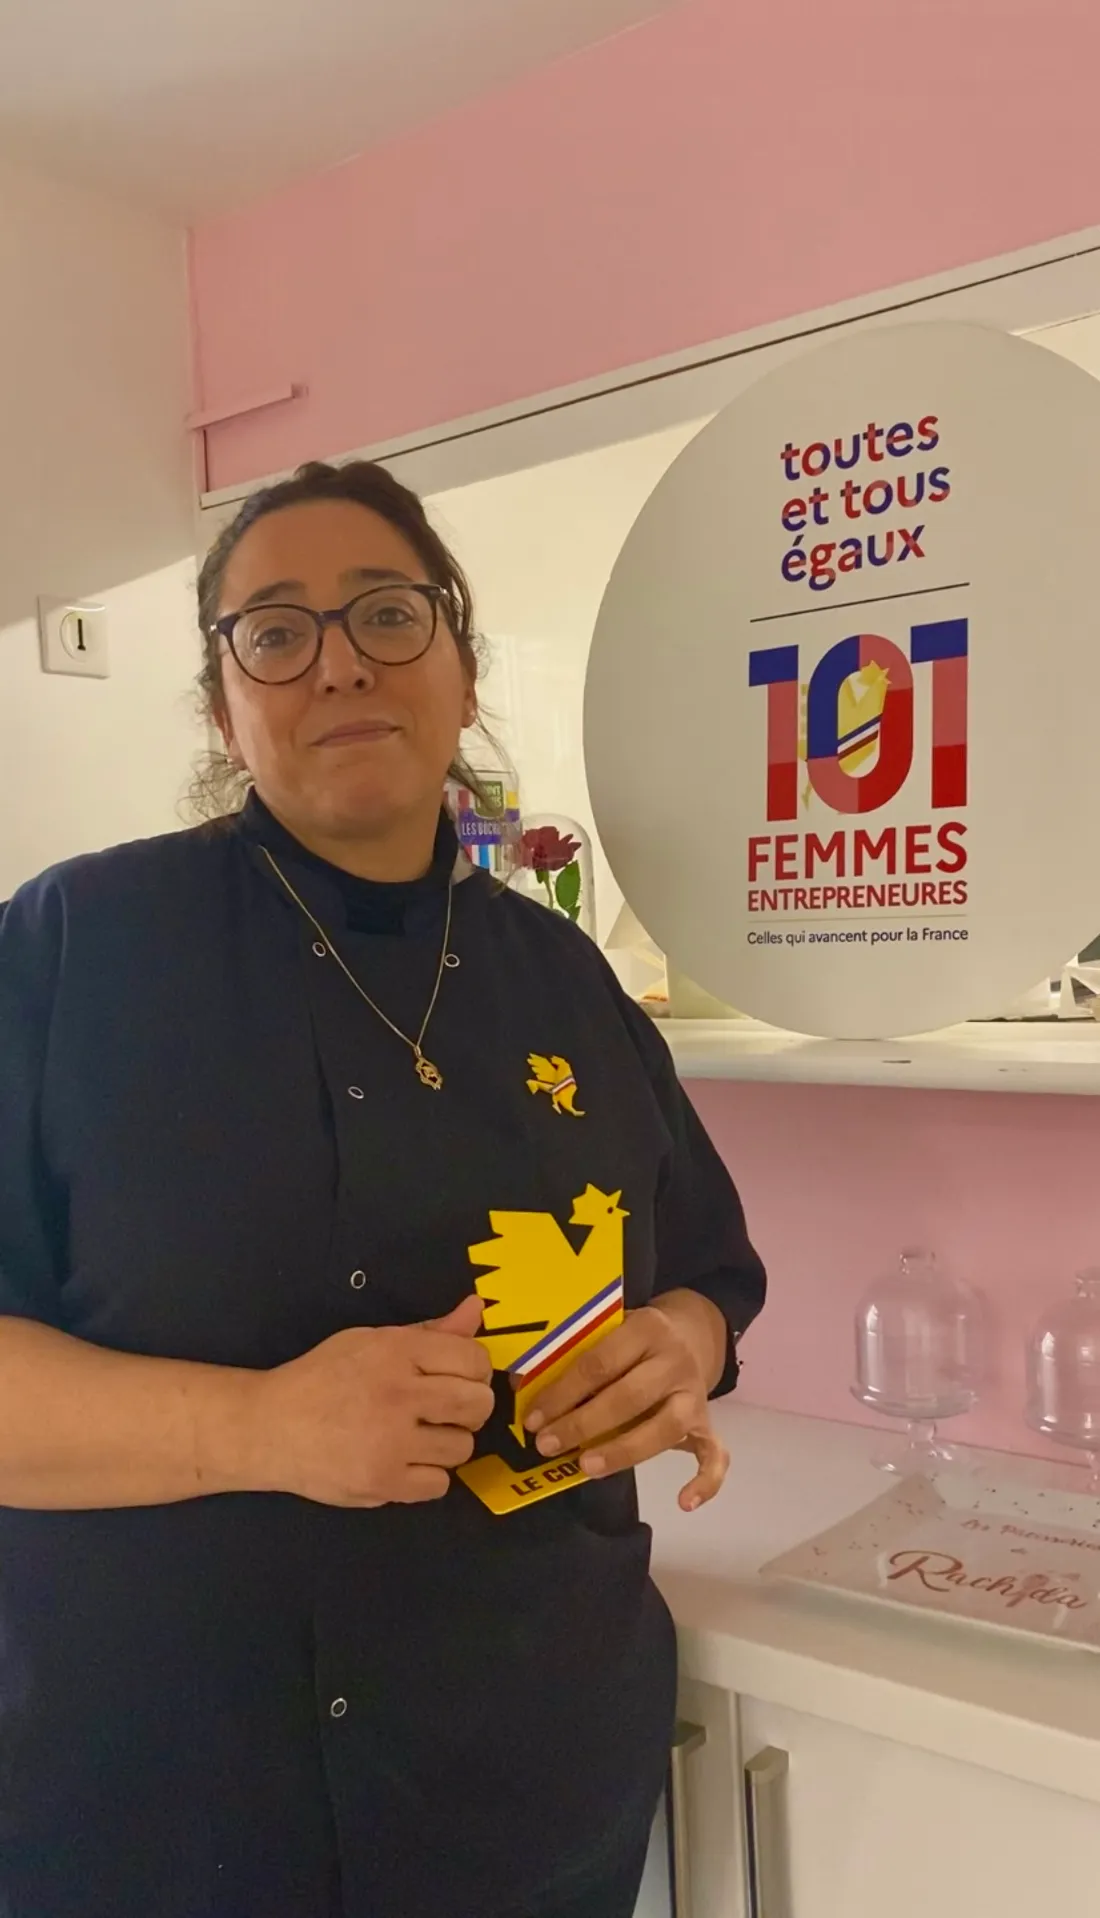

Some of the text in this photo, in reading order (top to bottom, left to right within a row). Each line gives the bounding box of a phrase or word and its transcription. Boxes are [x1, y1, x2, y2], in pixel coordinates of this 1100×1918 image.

[780, 415, 940, 481] toutes
[781, 467, 951, 531] et tous
[780, 524, 926, 591] égaux
[749, 617, 969, 822] 101
[748, 821, 969, 883] FEMMES
[748, 879, 969, 912] ENTREPRENEURES
[747, 927, 969, 947] Celles qui avancent pour la France
[510, 1477, 542, 1496] LE
